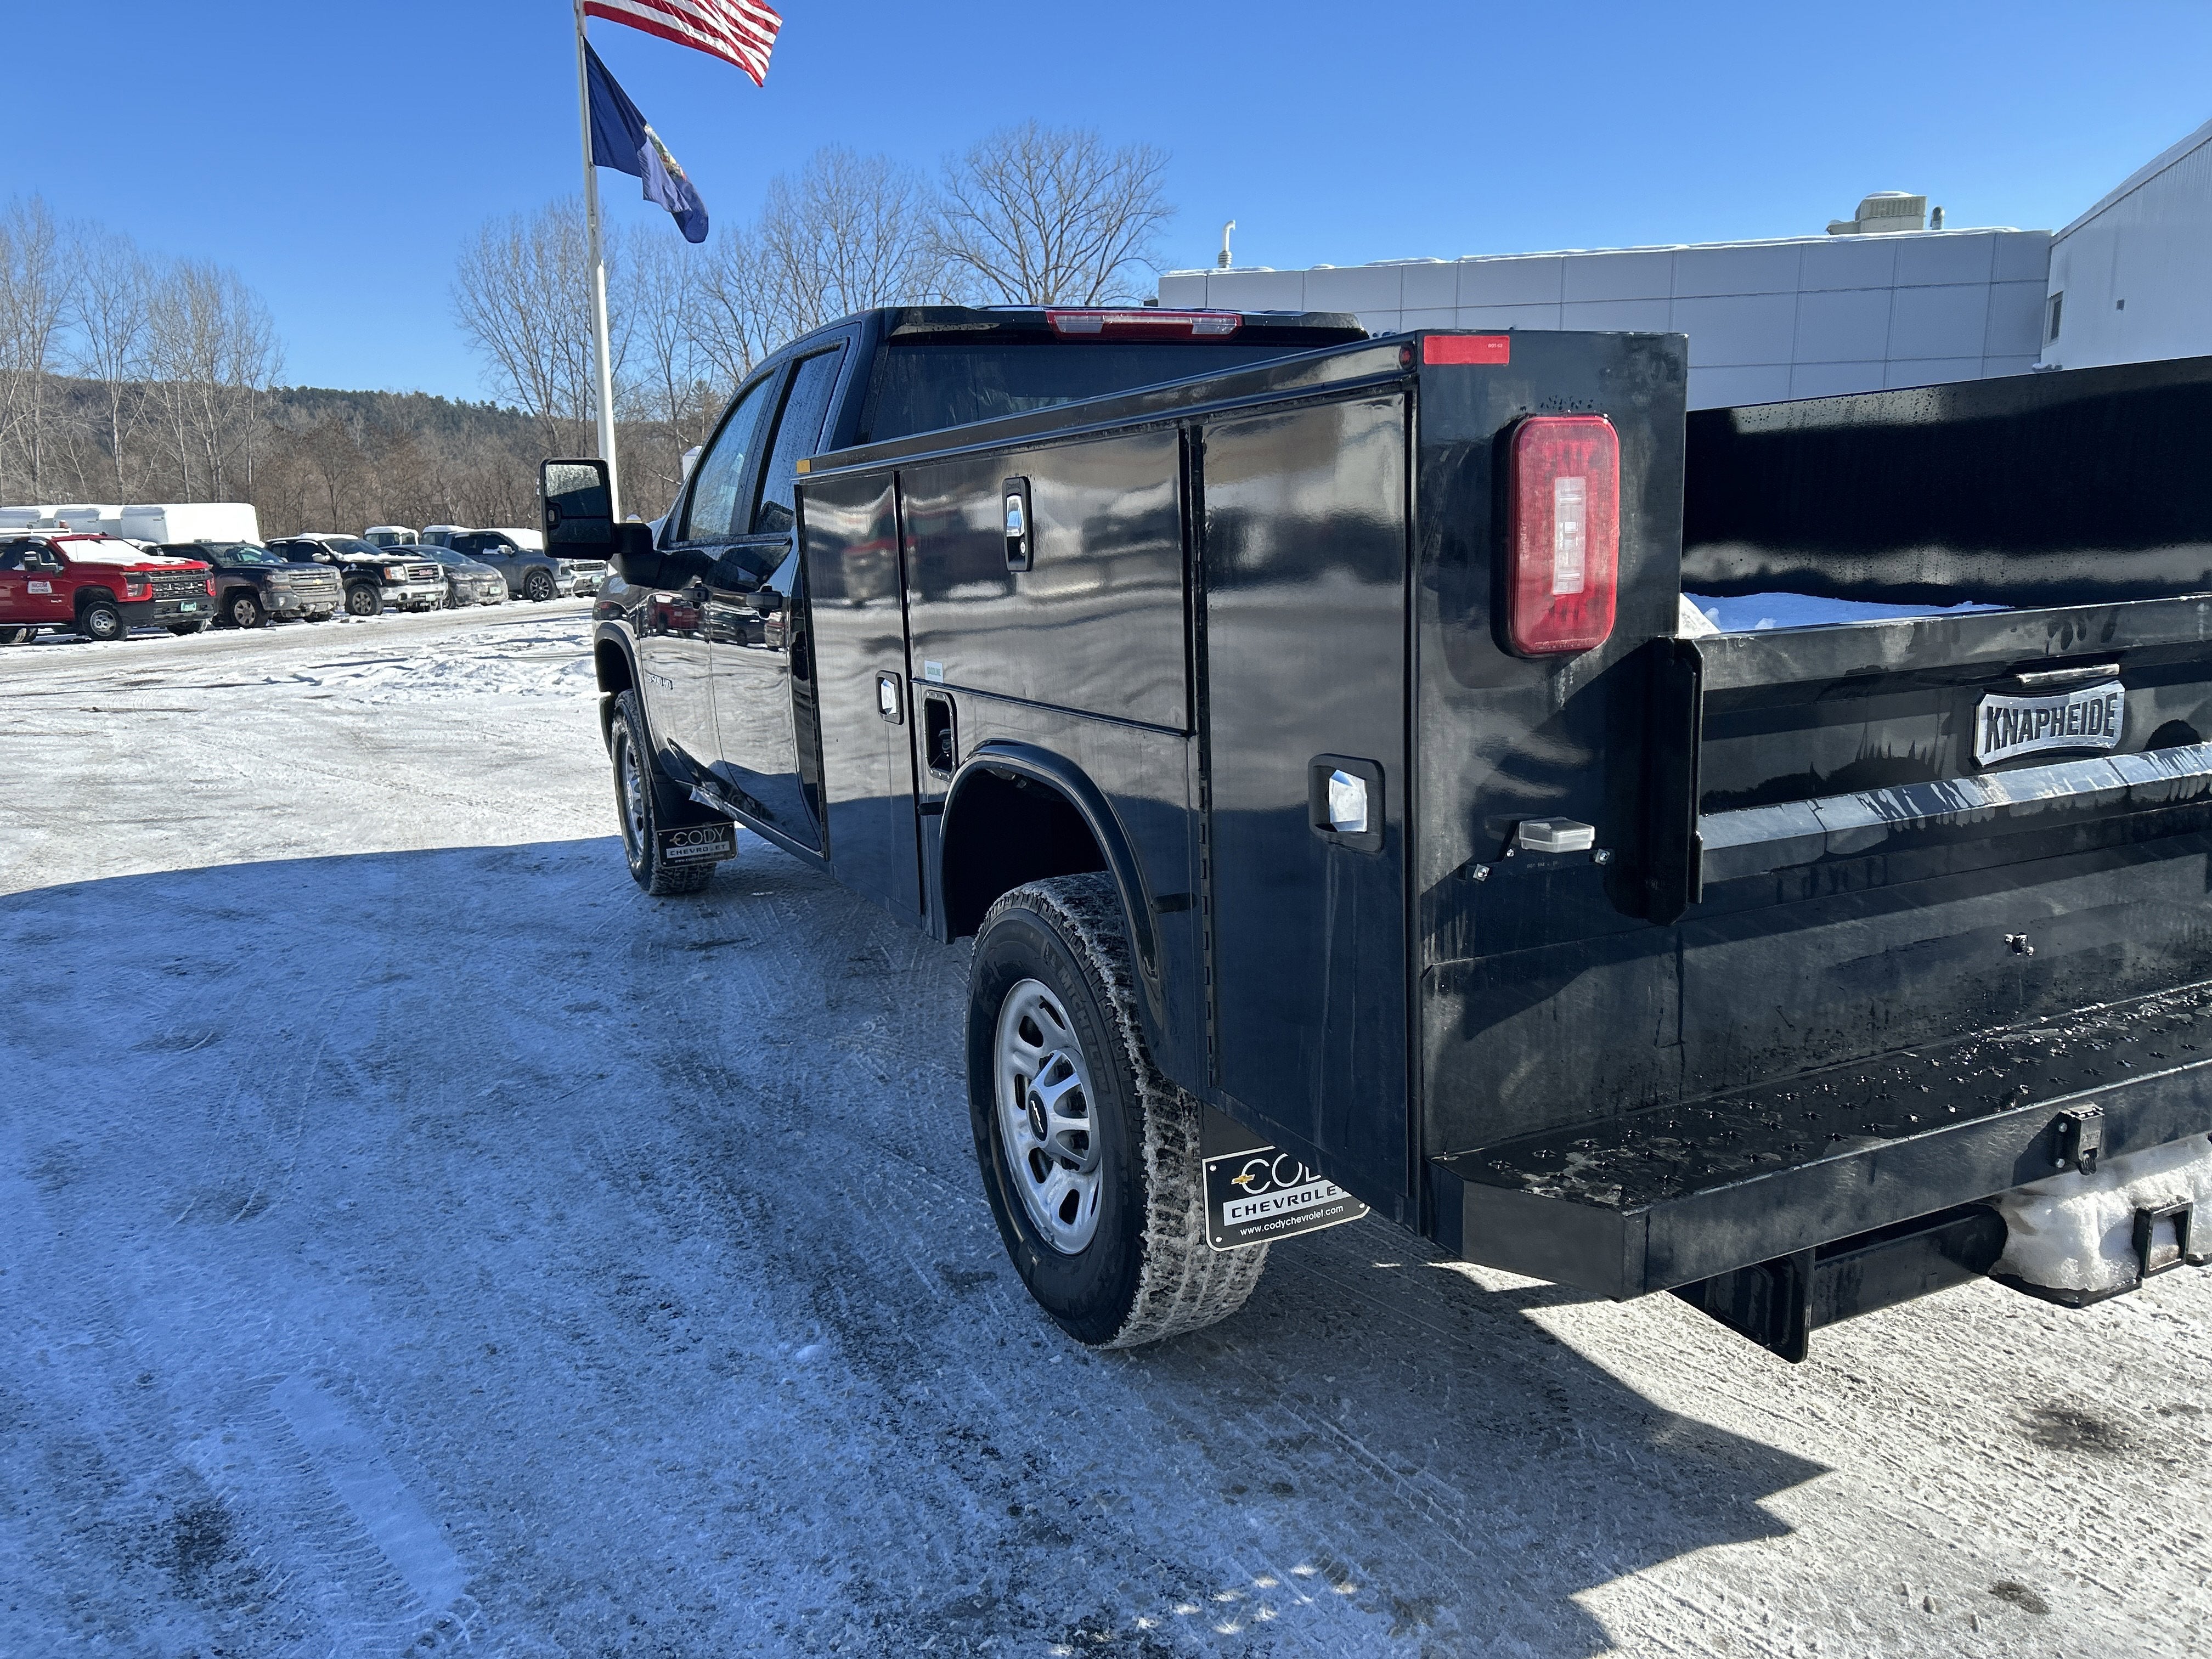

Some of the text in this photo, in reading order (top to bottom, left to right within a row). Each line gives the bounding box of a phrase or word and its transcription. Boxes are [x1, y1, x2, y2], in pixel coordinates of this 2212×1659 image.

[1984, 692, 2118, 755] KNAPHEIDE
[670, 844, 726, 856] CHEVROET
[673, 826, 725, 847] CODY
[1231, 1185, 1345, 1219] CHEVROLE
[1240, 1204, 1344, 1236] www.codychevrolet.com
